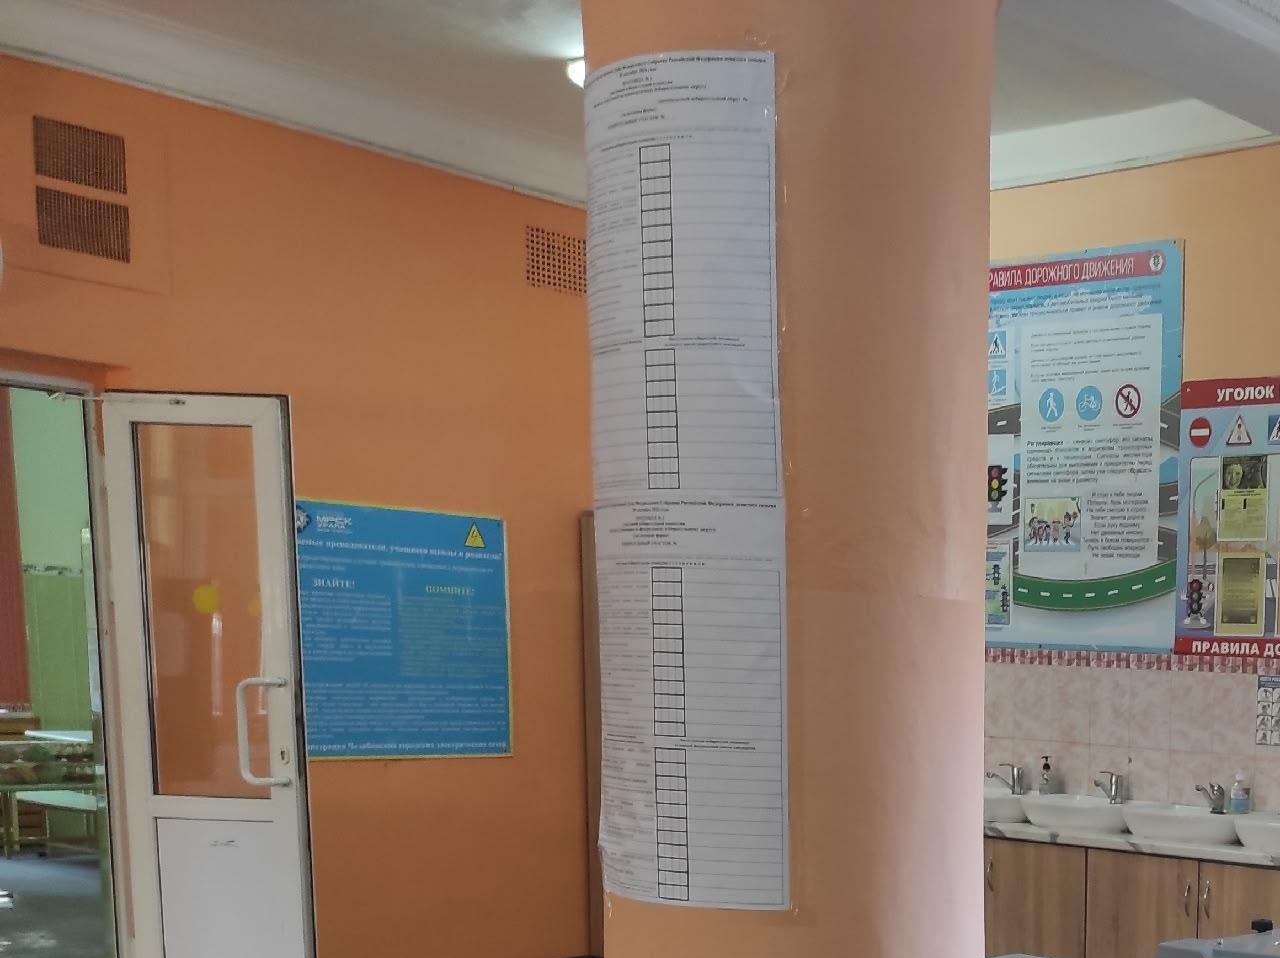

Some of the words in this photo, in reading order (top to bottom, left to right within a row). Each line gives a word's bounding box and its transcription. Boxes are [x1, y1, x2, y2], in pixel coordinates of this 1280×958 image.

[989, 269, 1022, 288] РАВИЛА
[1024, 267, 1080, 286] ДОРОЖНОГО
[1081, 257, 1135, 280] ДВИЖЕНИЯ
[1216, 384, 1274, 402] УГОЛОК
[1191, 640, 1260, 655] ПРАВИЛА
